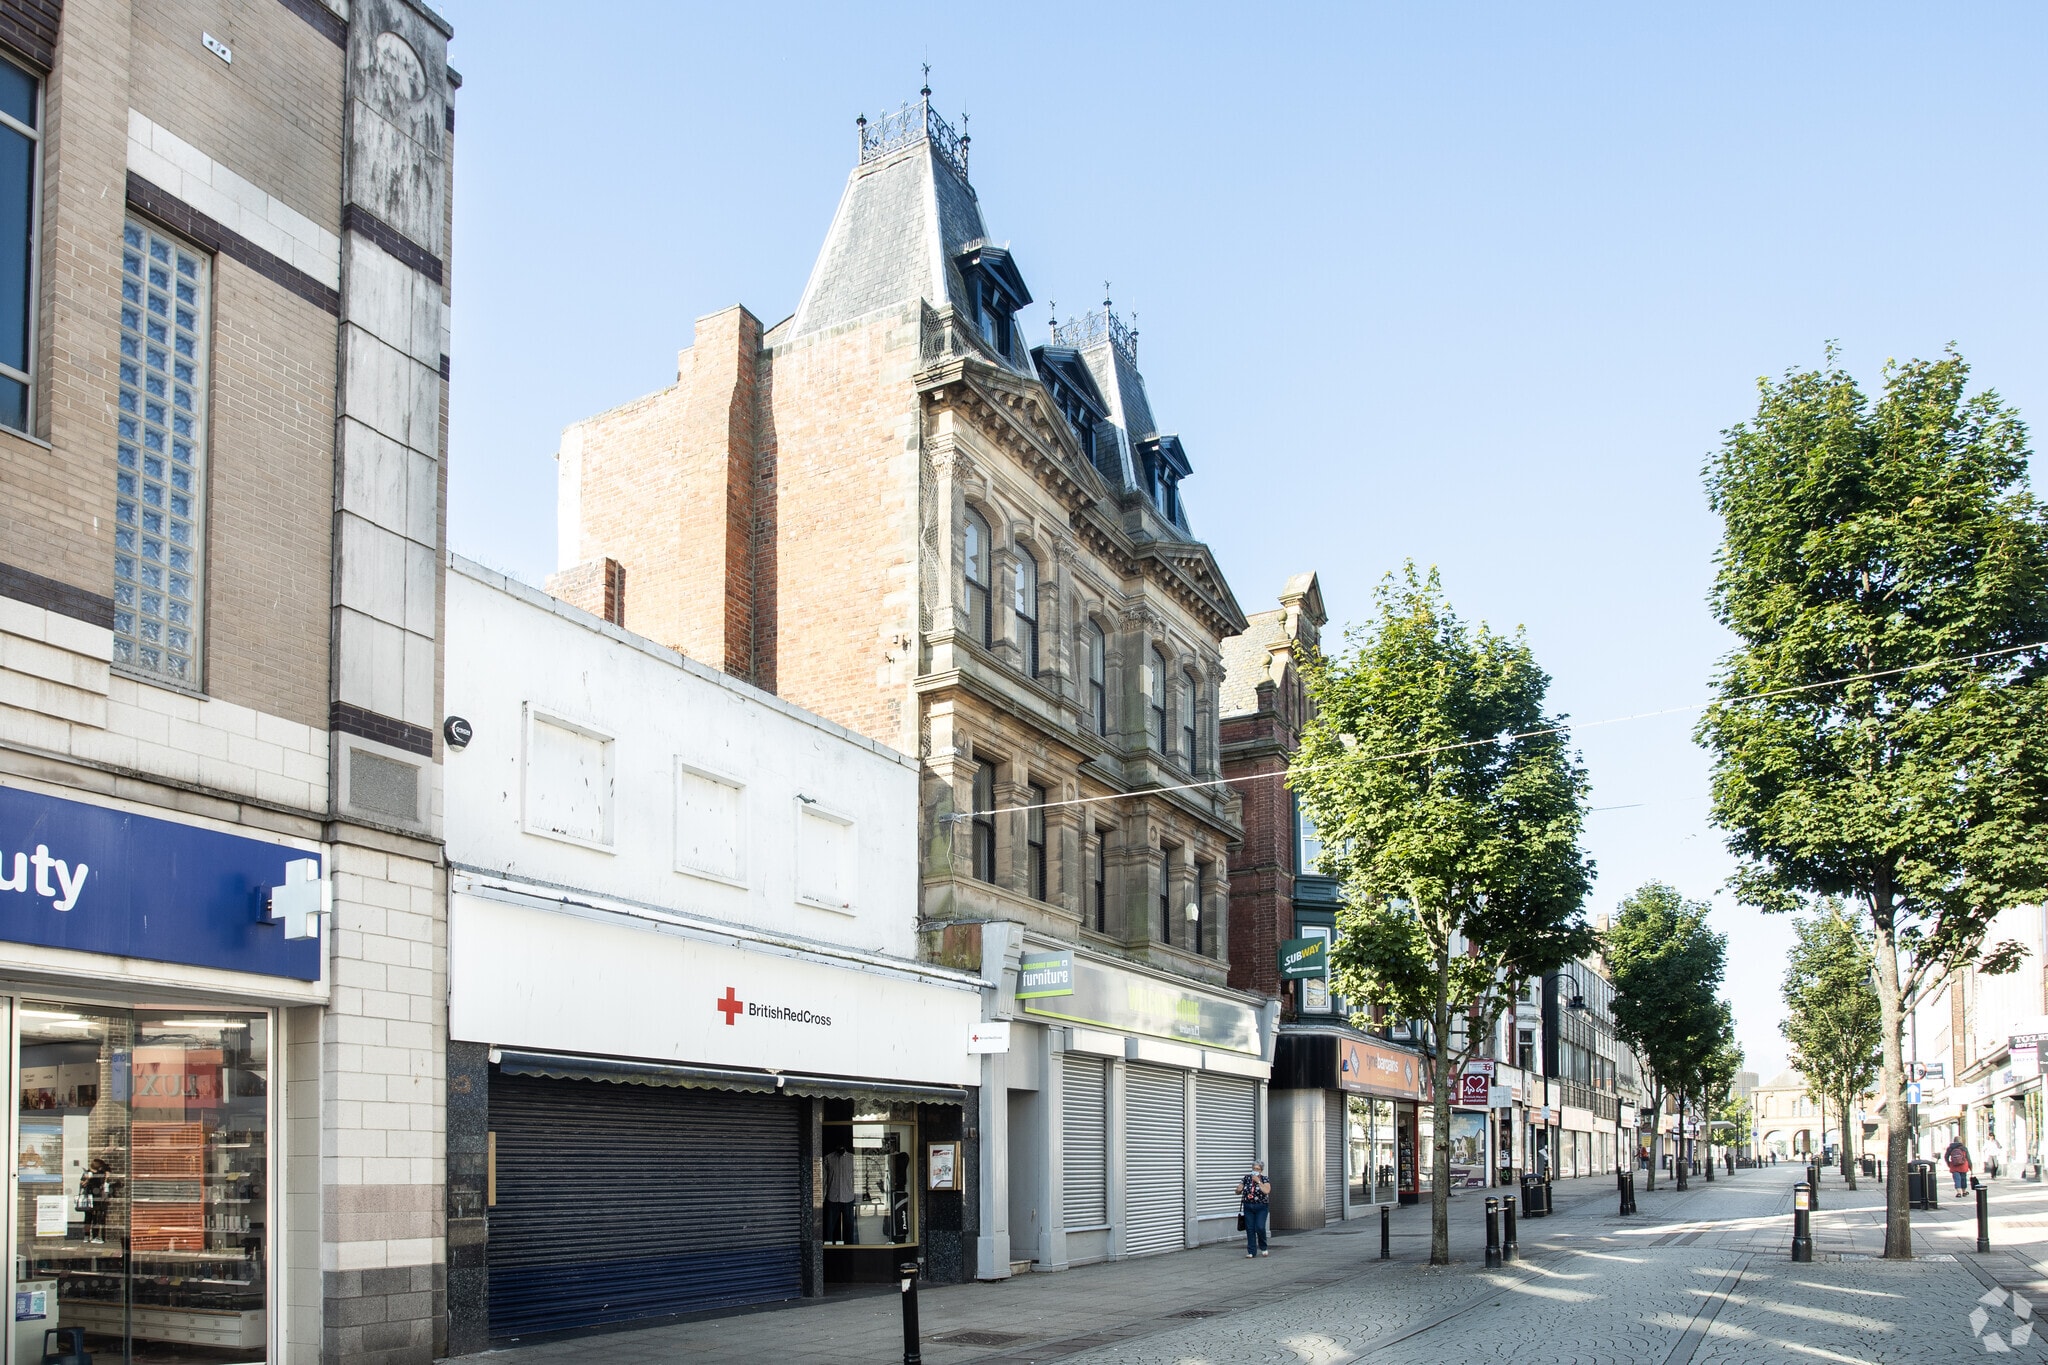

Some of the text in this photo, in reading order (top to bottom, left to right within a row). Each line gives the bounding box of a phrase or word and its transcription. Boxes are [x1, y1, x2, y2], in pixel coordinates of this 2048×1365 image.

[0, 844, 89, 911] uty
[1284, 942, 1323, 966] SUBWAY
[1022, 969, 1068, 987] furniture
[748, 1003, 832, 1027] BritishRedCross
